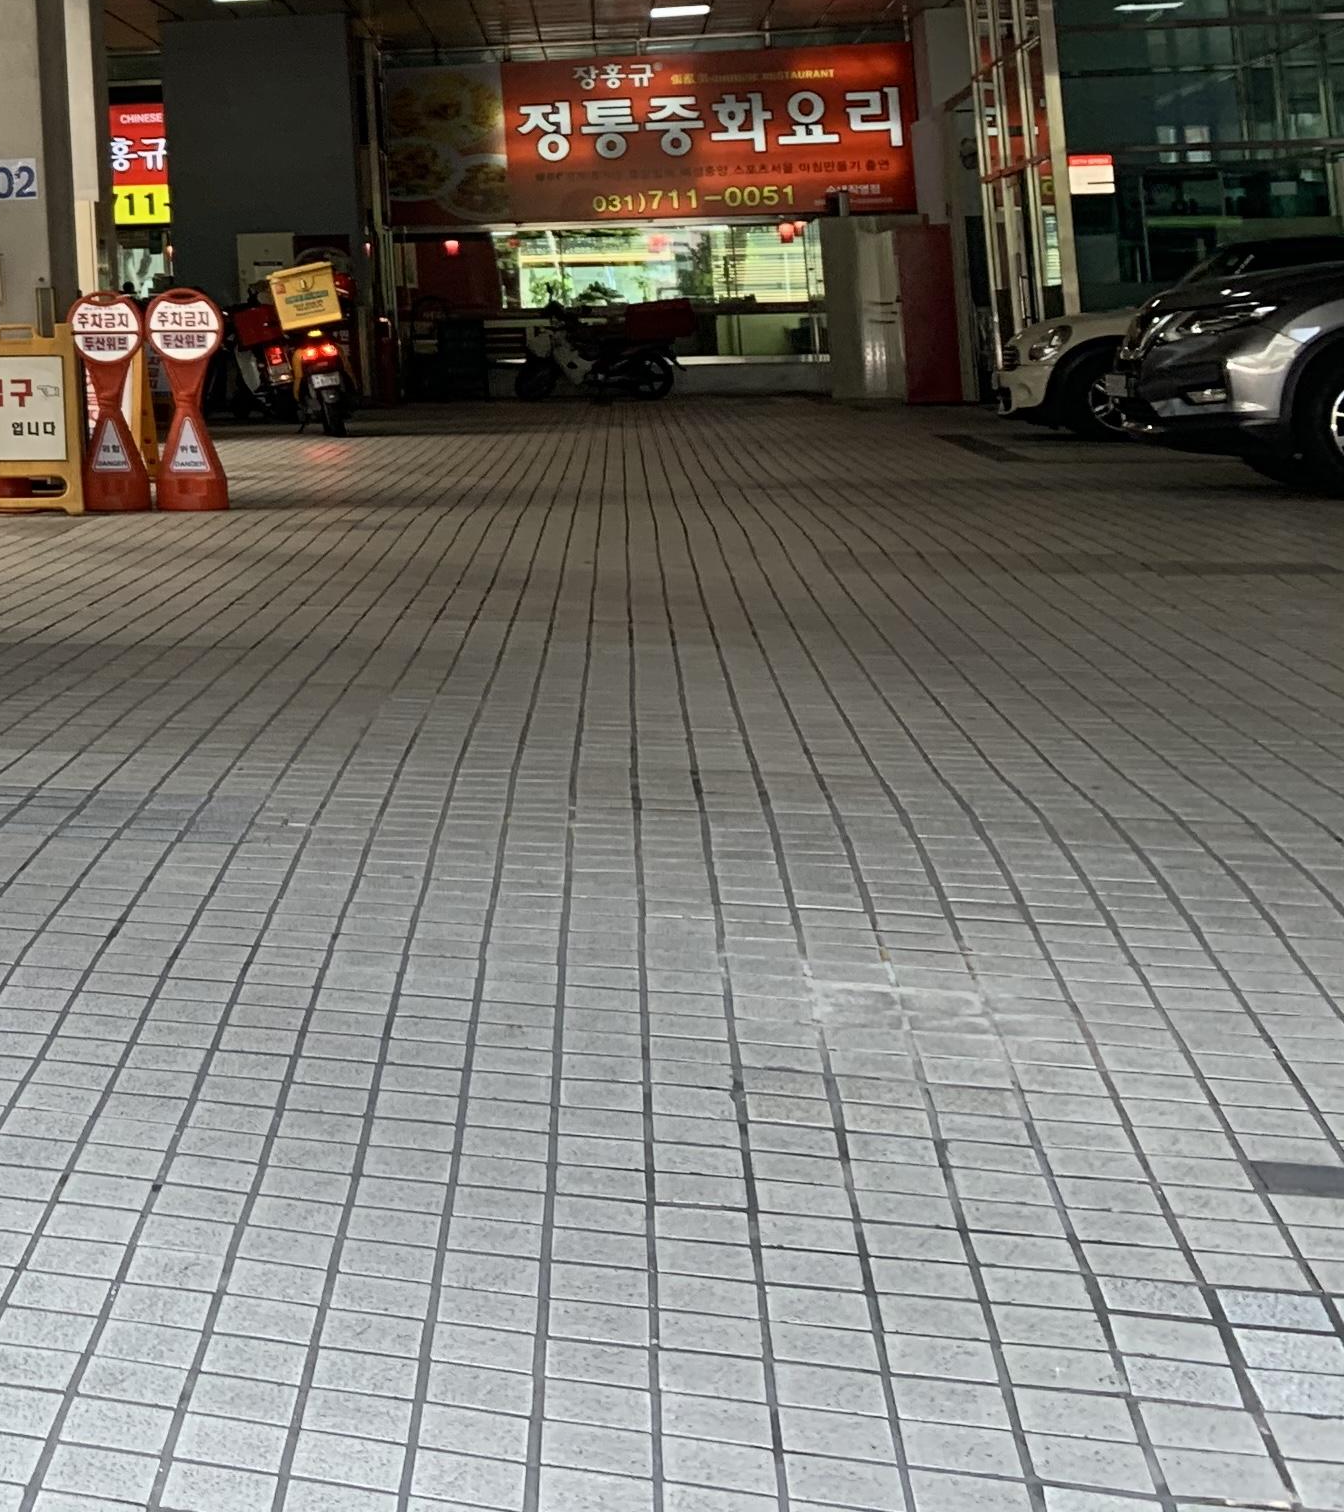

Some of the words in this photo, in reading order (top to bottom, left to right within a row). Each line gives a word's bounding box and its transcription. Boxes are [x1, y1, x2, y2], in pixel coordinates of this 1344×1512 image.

[572, 63, 655, 90] 장홍규
[119, 112, 164, 125] CHINESE
[516, 86, 904, 162] 정통중화요리
[592, 184, 796, 213] 031)711-0051
[77, 312, 130, 329] 주차금지
[157, 311, 210, 328] 주차금지
[83, 336, 129, 351] 두산위브
[161, 332, 208, 349] 두산위브
[11, 421, 56, 437] 입니다
